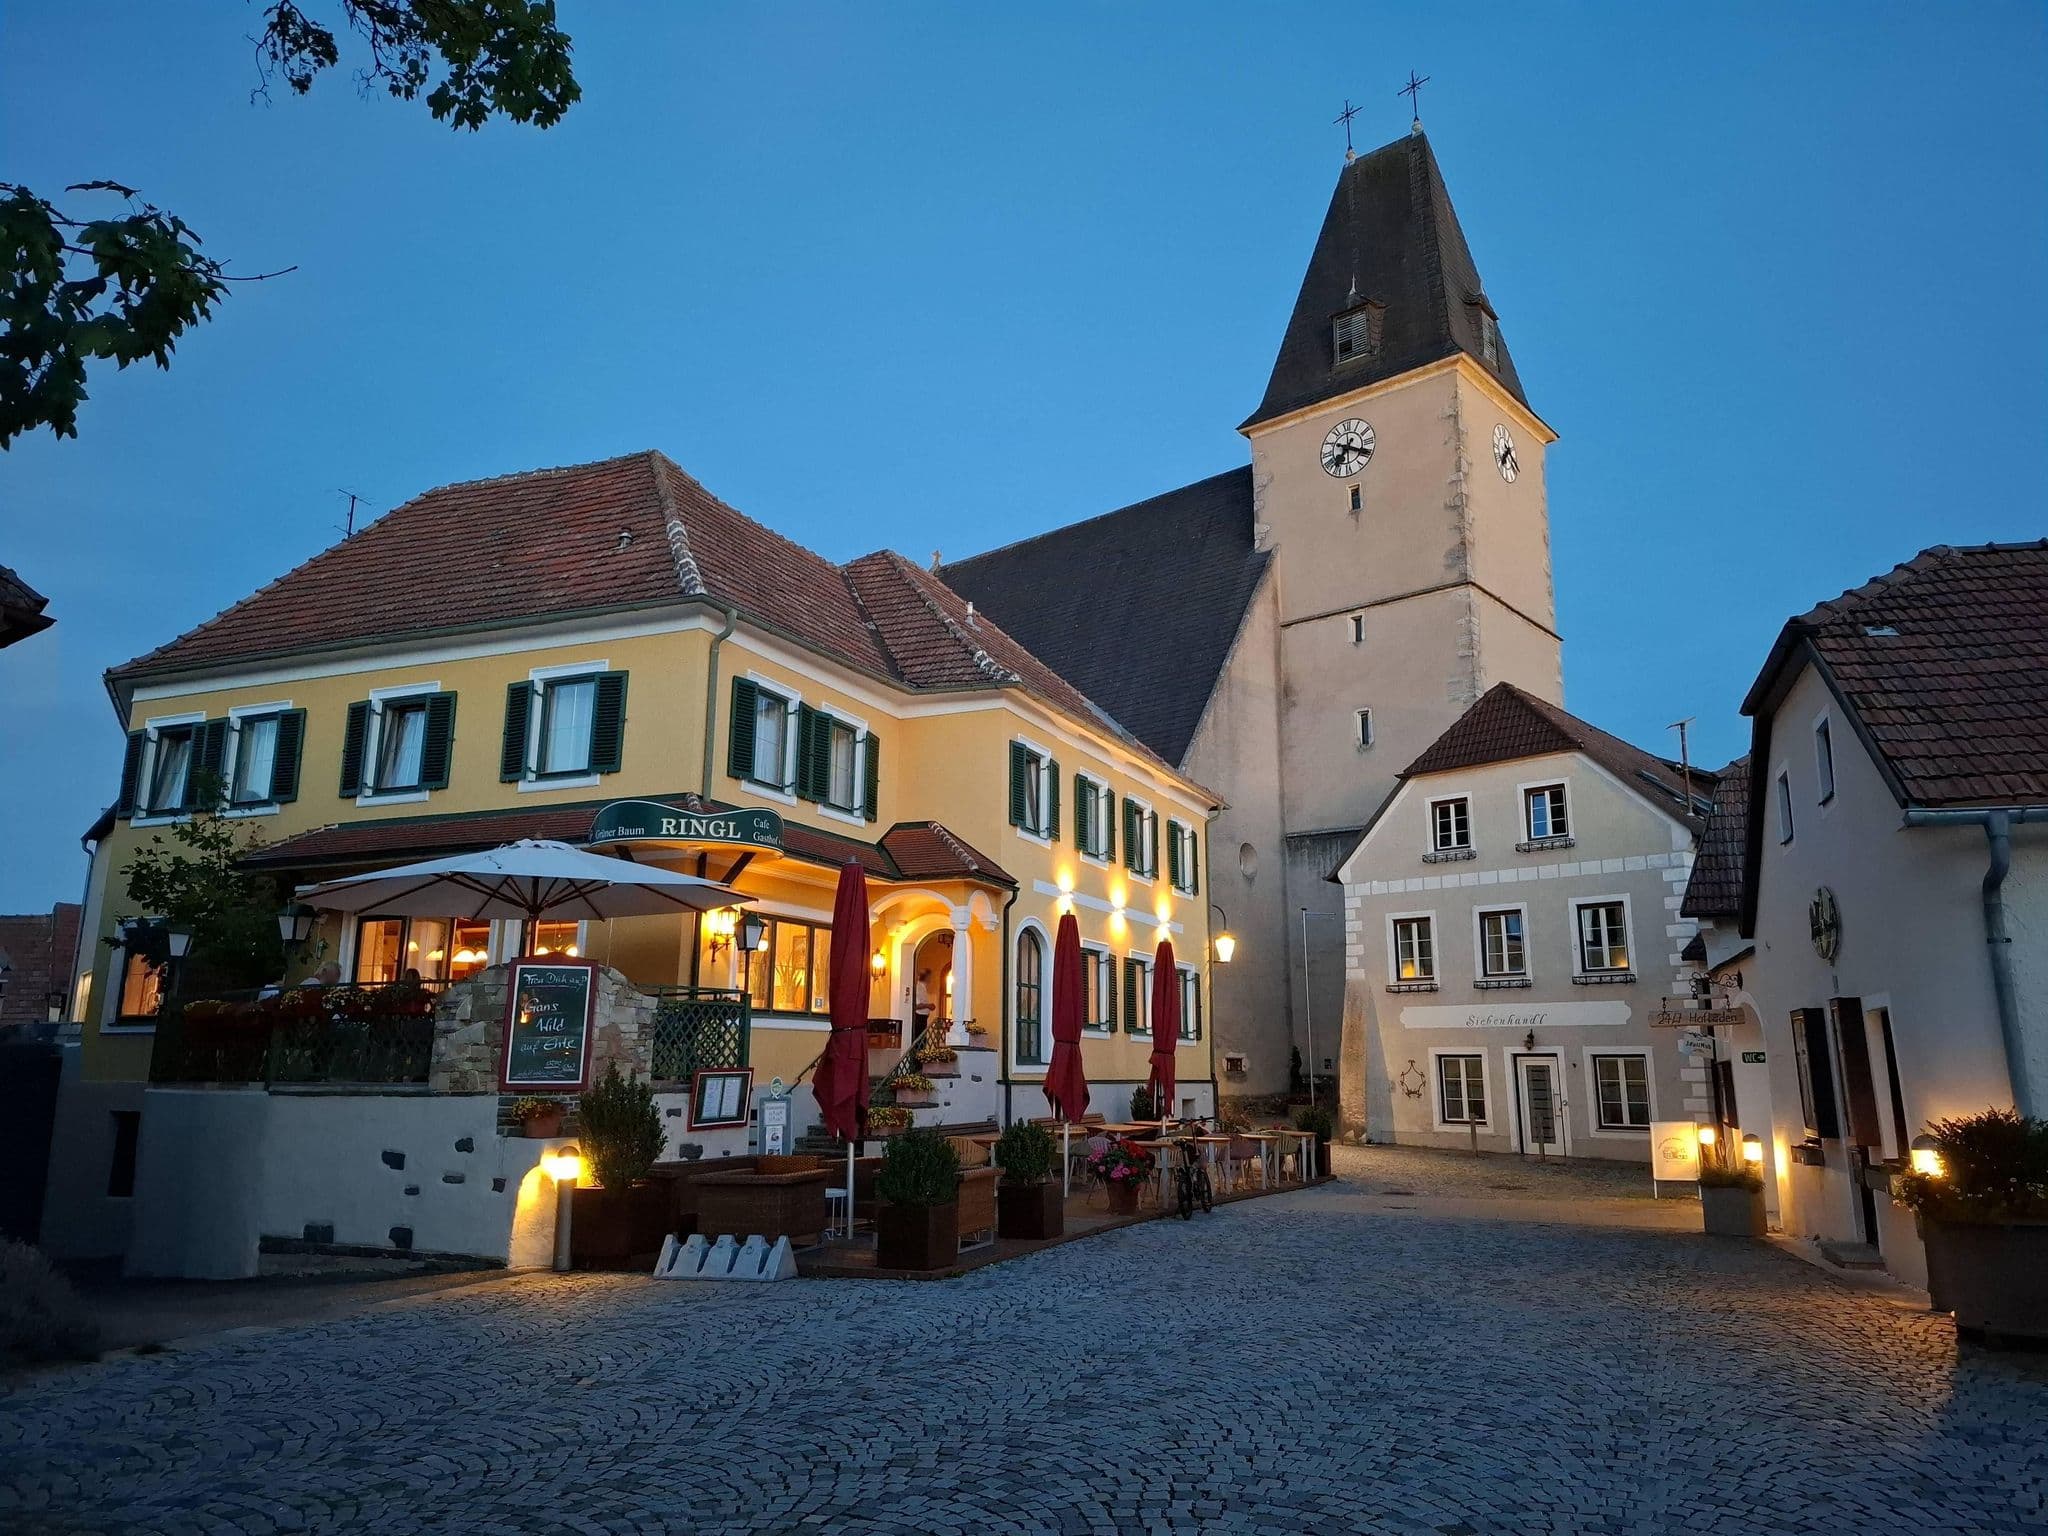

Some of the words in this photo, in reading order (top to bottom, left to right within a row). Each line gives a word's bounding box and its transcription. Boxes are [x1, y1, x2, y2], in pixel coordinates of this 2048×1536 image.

[594, 828, 617, 840] Grüner
[617, 825, 645, 837] Baum
[659, 817, 742, 839] RINGL
[524, 997, 559, 1013] Gans
[535, 1017, 566, 1033] Wild
[1464, 1013, 1548, 1029] Siebenhandl
[1743, 1052, 1756, 1063] WC
